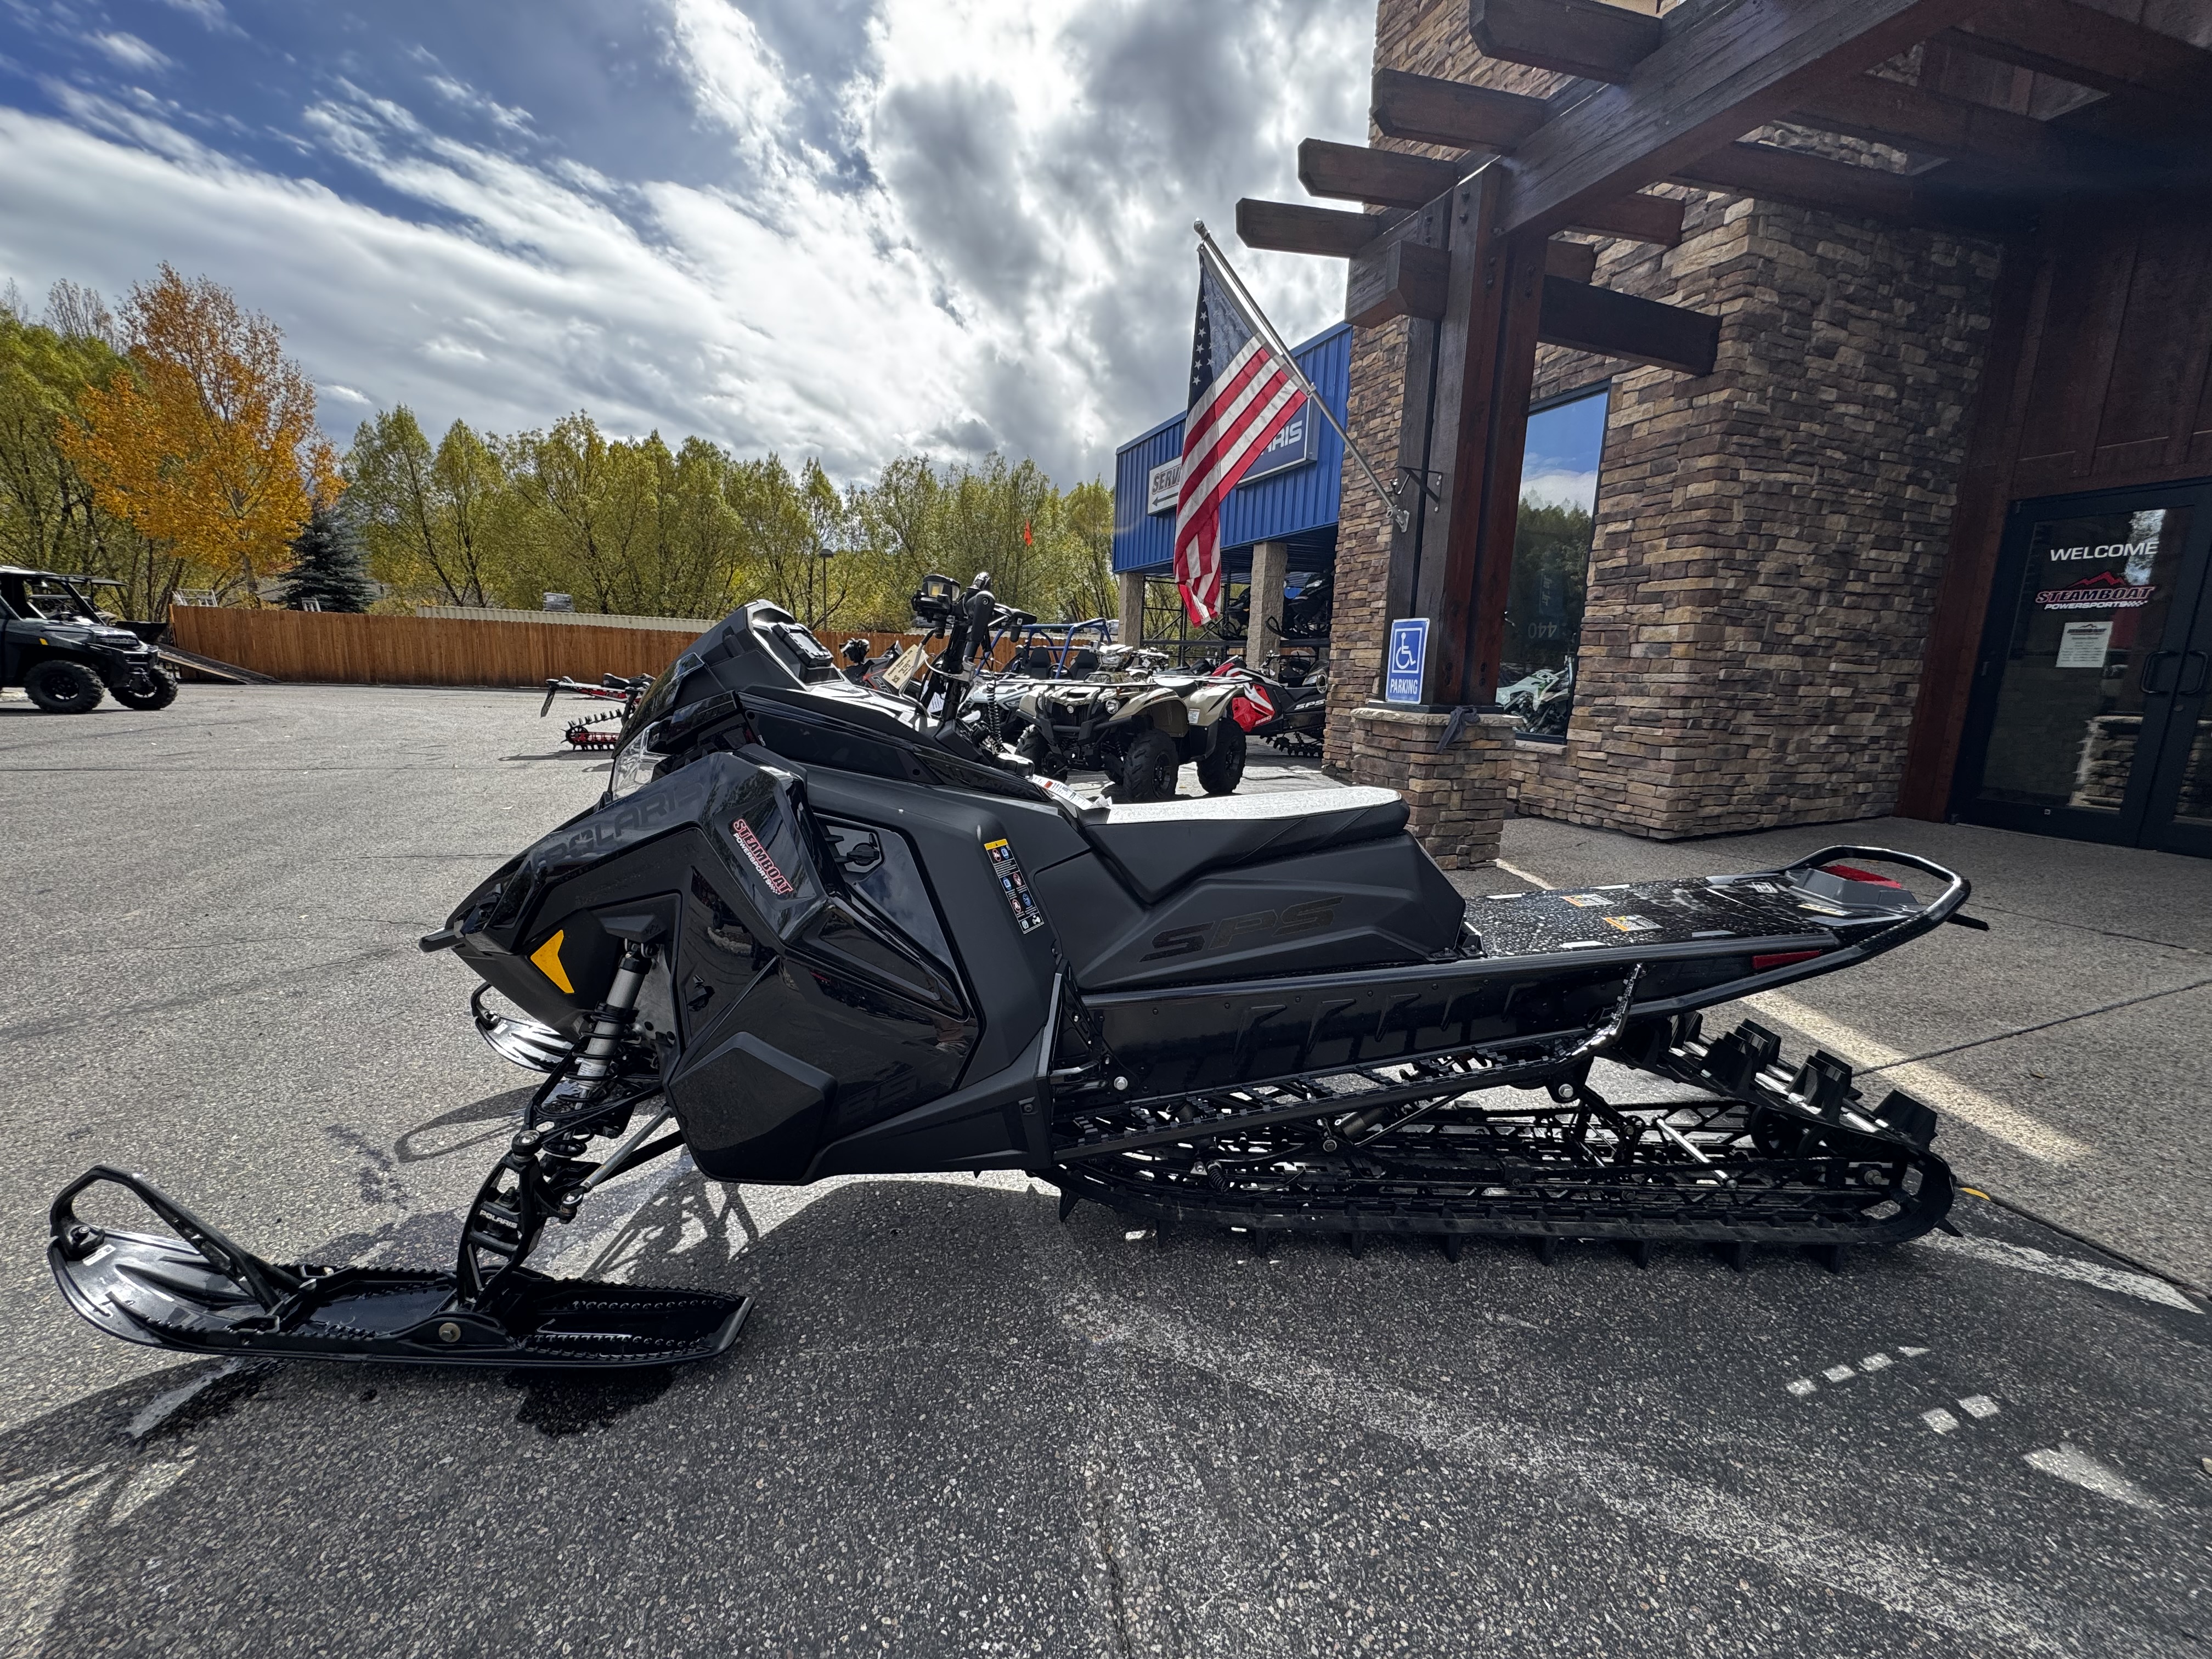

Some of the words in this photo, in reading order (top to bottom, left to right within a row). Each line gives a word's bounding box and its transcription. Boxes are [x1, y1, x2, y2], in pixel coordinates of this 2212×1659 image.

[1152, 464, 1181, 495] SERV
[2051, 541, 2159, 561] WELCOME
[2035, 586, 2156, 603] STEAMBOAT
[2044, 601, 2129, 610] POWERSPORTS
[1528, 621, 1557, 639] 440
[1390, 678, 1418, 695] PARKING
[1294, 699, 1325, 710] SPS
[544, 782, 703, 871] POLARIS
[733, 819, 794, 894] STEAMBOAT
[733, 832, 772, 887] POWERSPORTS
[1138, 895, 1344, 962] SPS
[479, 1209, 518, 1229] POLARIS
